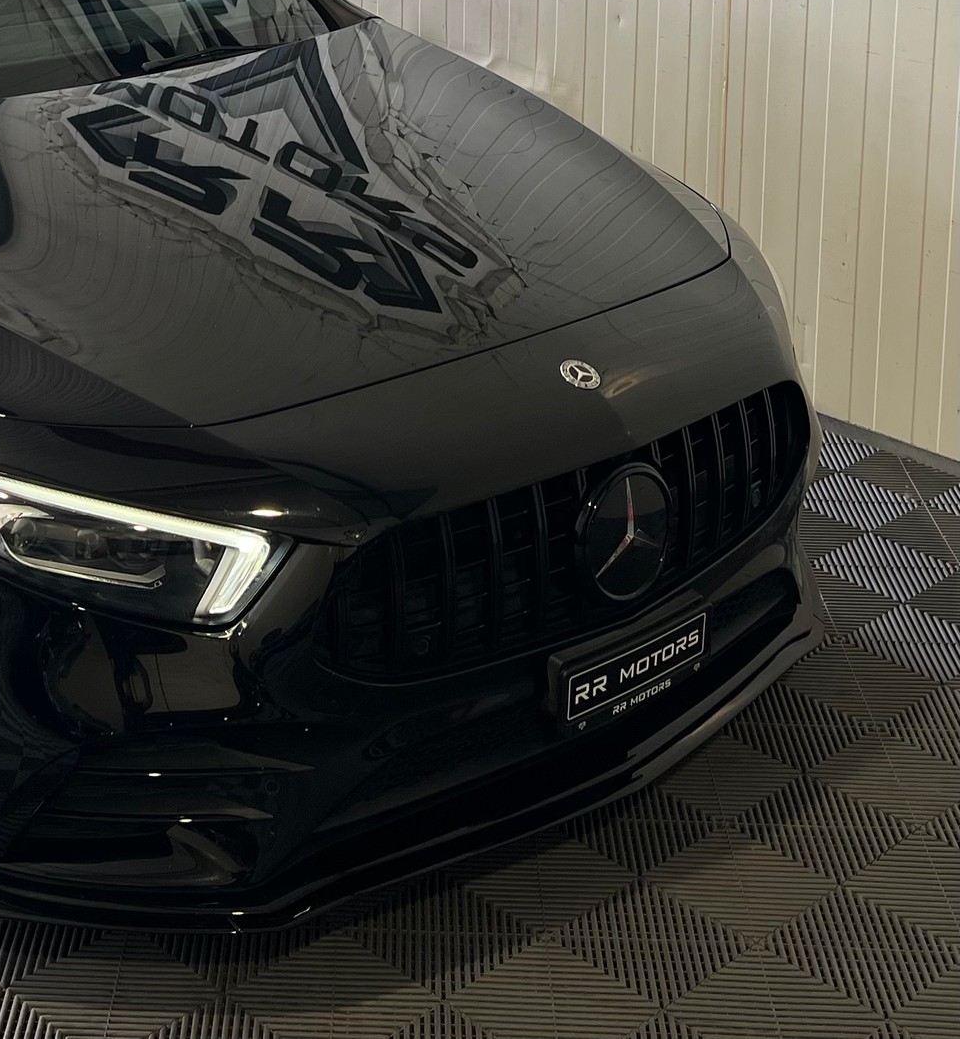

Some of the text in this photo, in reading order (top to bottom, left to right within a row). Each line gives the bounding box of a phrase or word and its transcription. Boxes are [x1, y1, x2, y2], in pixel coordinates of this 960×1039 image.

[574, 629, 699, 705] RR MOTORS
[612, 678, 672, 715] RR MOTORS
